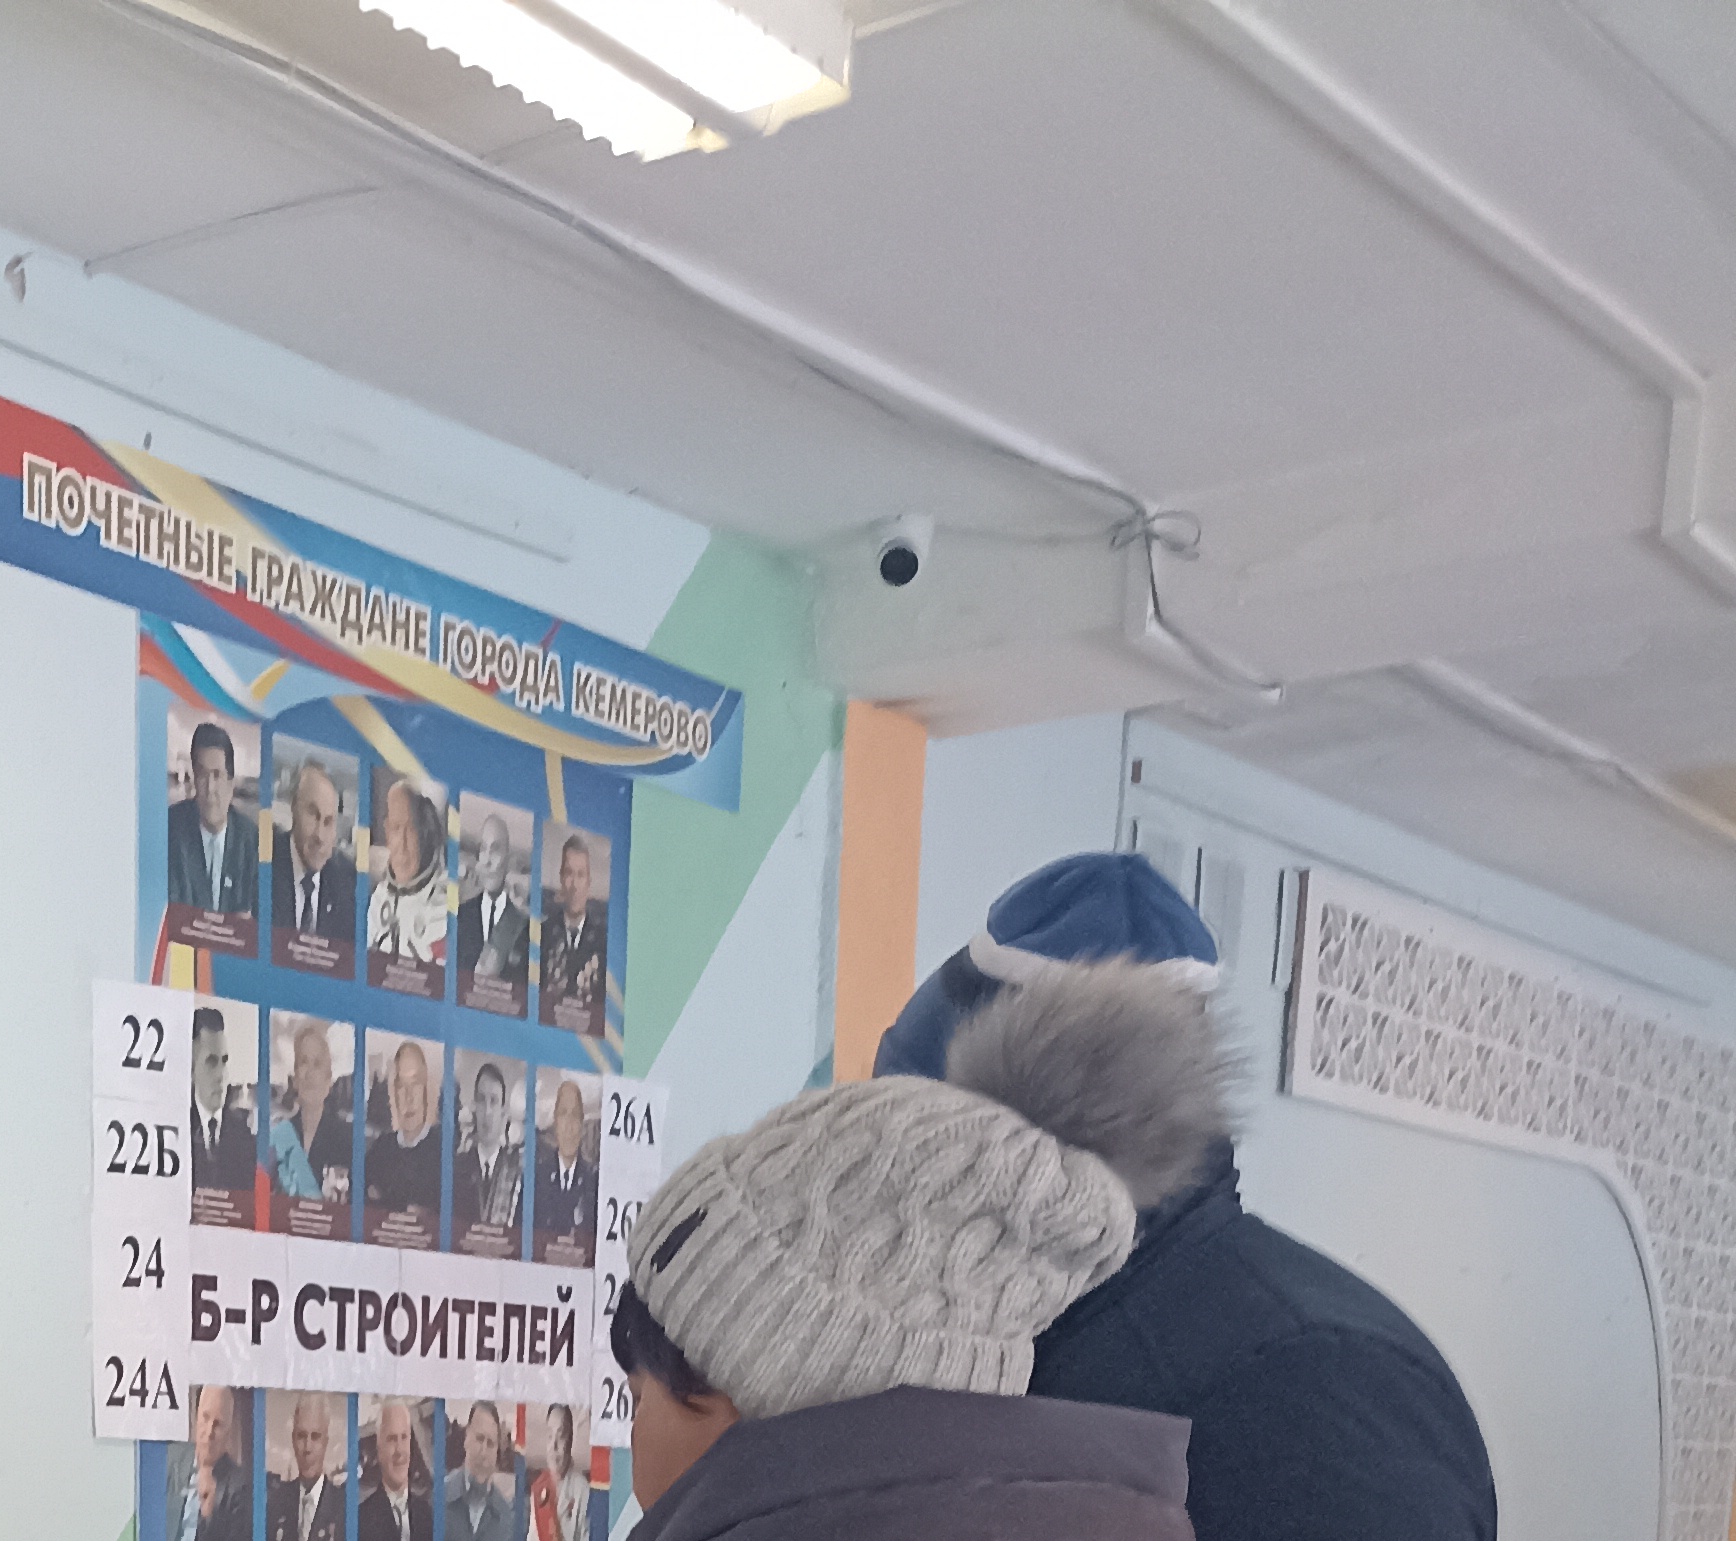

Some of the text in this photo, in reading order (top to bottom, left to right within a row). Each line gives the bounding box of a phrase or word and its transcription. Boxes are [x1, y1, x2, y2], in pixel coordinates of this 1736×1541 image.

[22, 452, 713, 762] ПОЧЕТНЫЕ ГРАЖДАНЕ ГОРОДА КЕМЕРОВО
[121, 1014, 167, 1072] 22
[608, 1091, 655, 1146] 26А
[106, 1119, 181, 1178] 22Б
[121, 1235, 166, 1290] 24
[190, 1273, 576, 1368] Б-Р СТРОИТЕЛЕЙ
[105, 1356, 180, 1411] 24А
